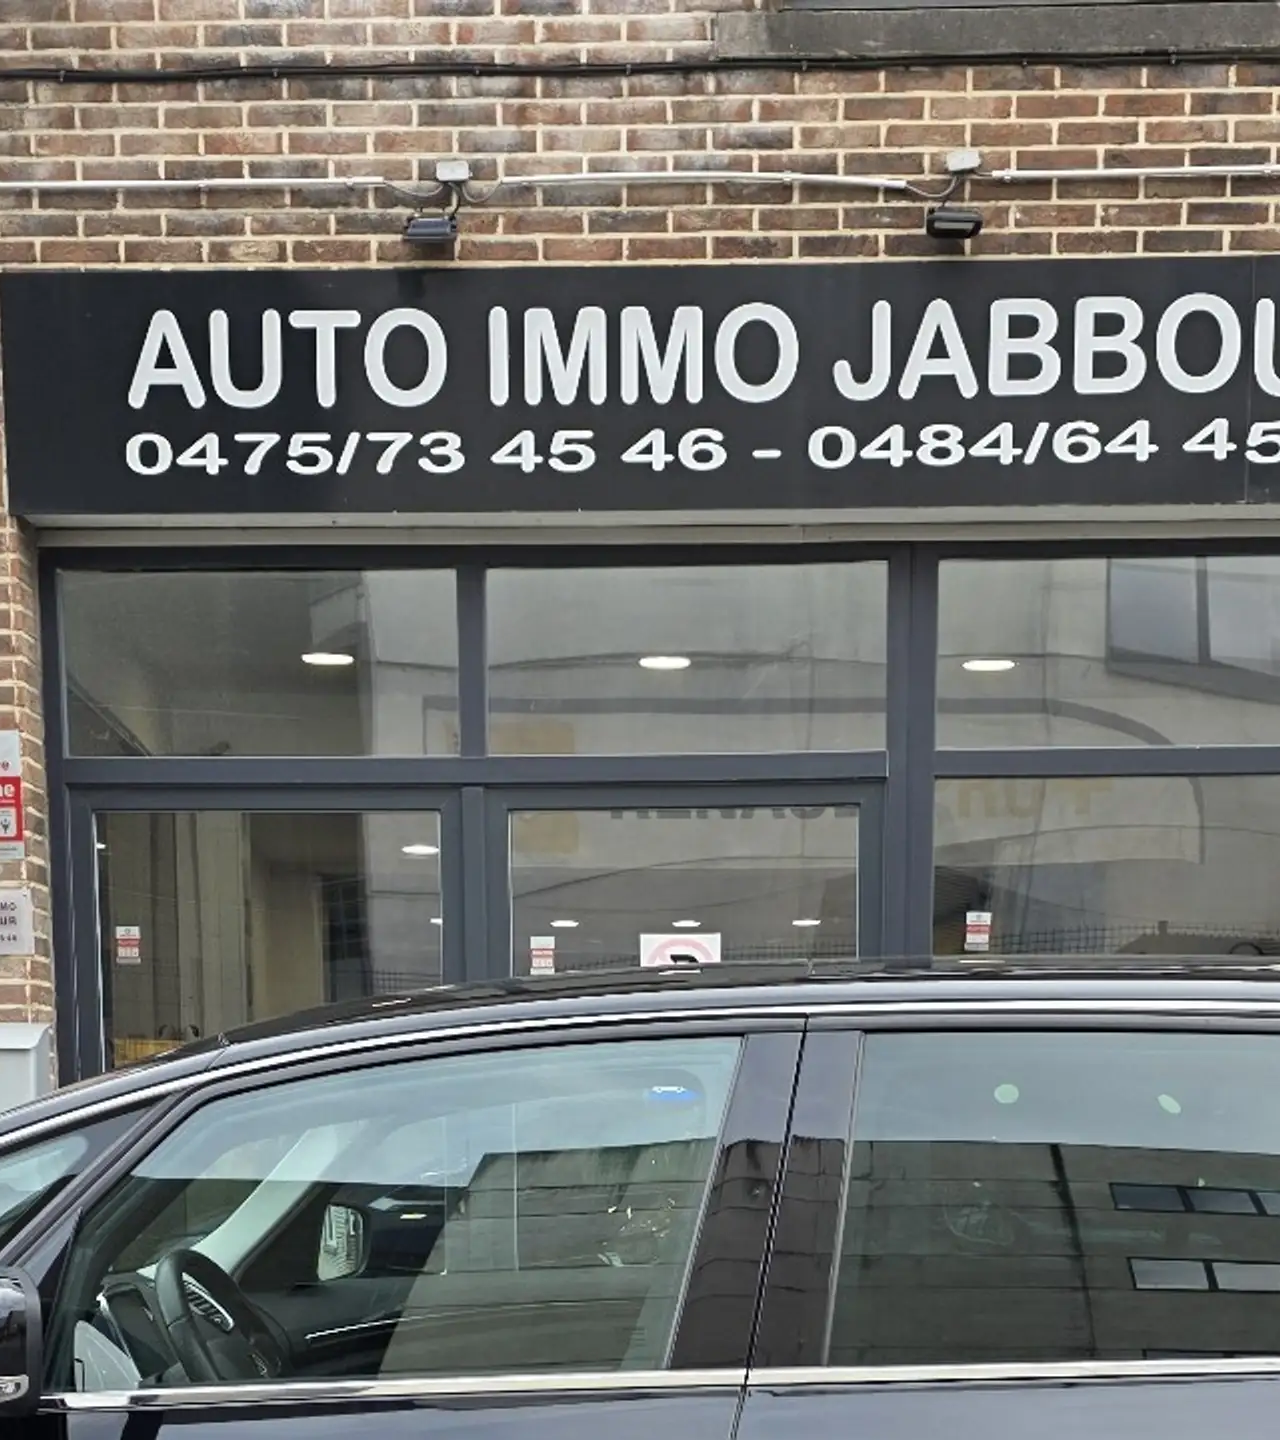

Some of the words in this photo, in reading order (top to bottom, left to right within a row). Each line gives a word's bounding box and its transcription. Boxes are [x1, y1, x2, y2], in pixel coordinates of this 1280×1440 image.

[126, 307, 448, 410] AUTO
[487, 301, 800, 407] IMMO
[124, 430, 466, 476] 0475/73
[489, 428, 597, 475] 45
[619, 427, 728, 472] 46
[751, 447, 782, 460] -
[806, 419, 1160, 470] 0484/64
